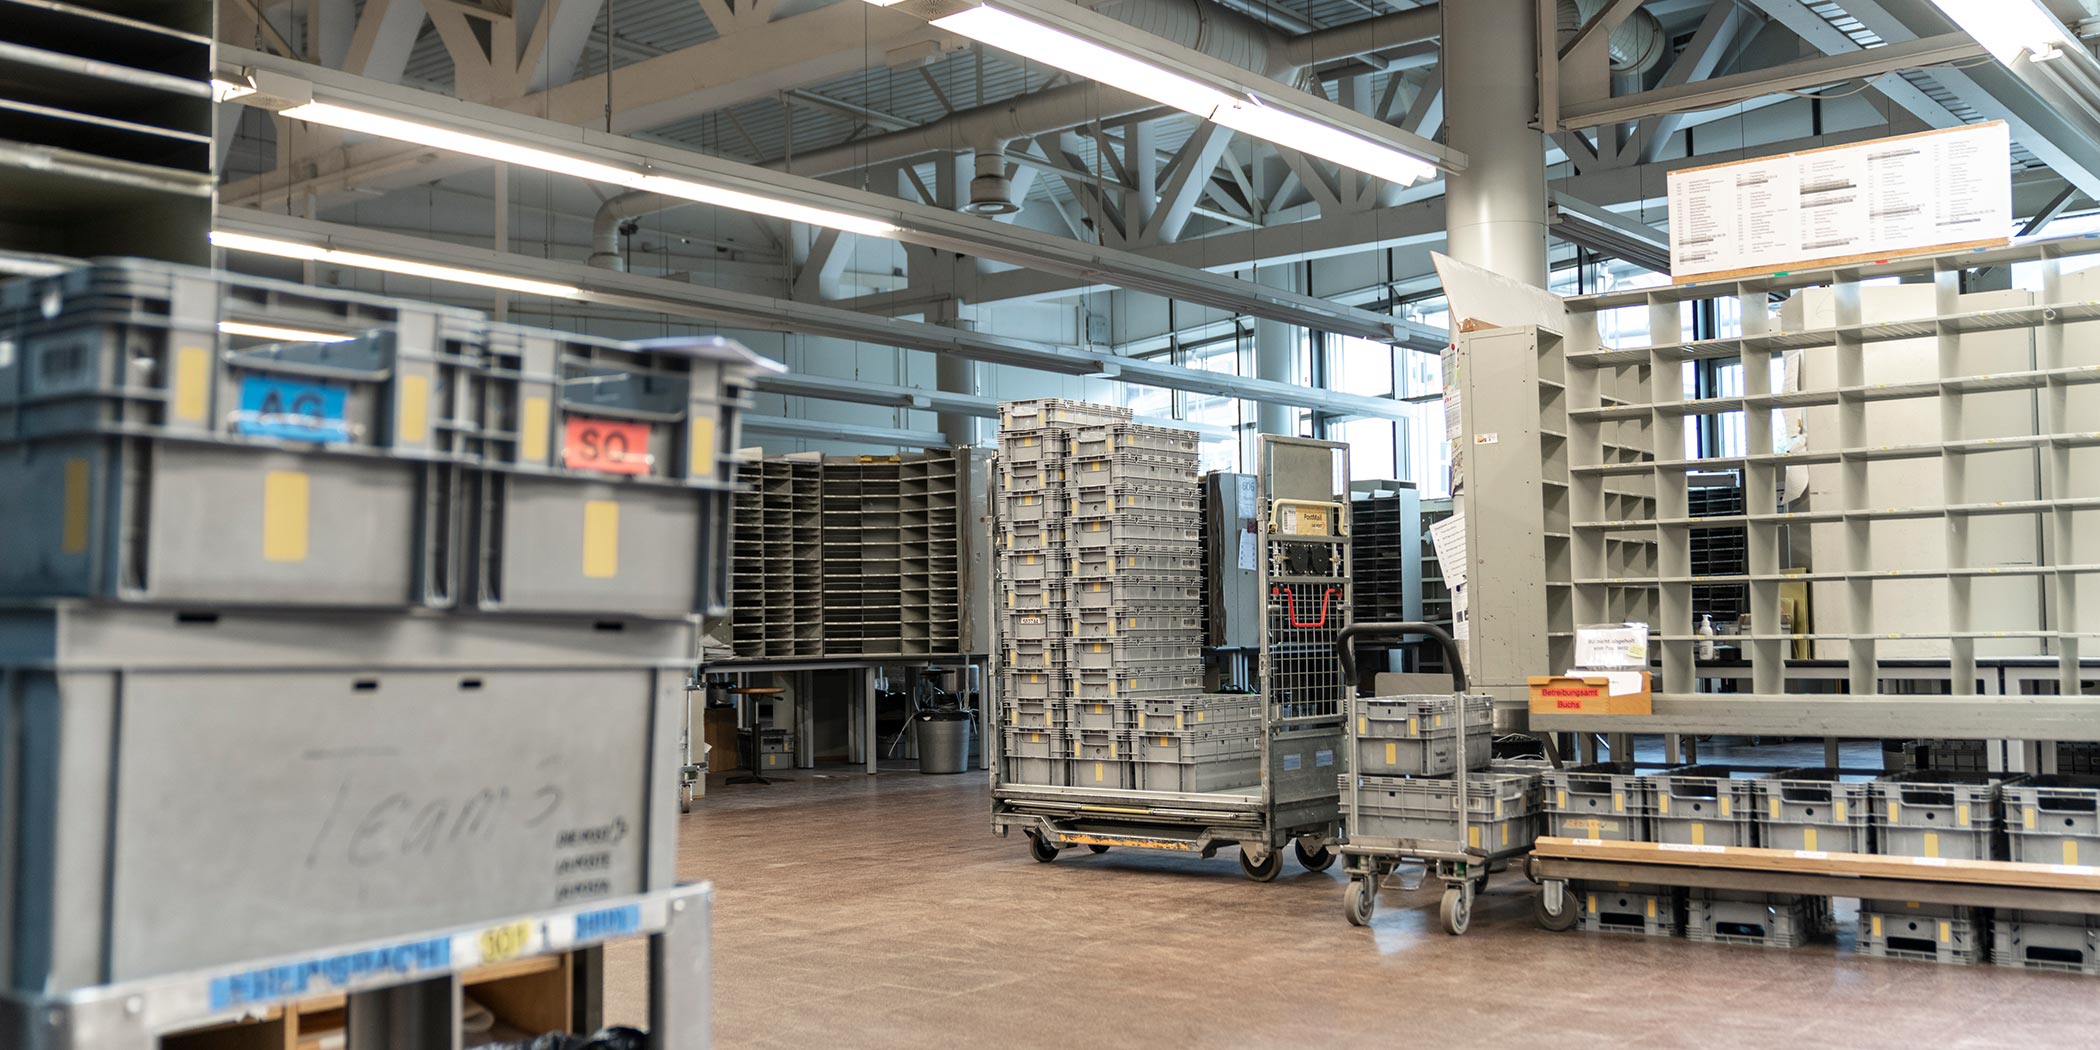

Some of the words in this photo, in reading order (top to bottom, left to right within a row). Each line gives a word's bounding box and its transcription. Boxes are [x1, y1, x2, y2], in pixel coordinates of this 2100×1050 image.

[259, 390, 325, 430] AG
[580, 427, 629, 463] SO
[1541, 688, 1599, 698] Betreibungsamt
[1557, 701, 1580, 709] Buchs
